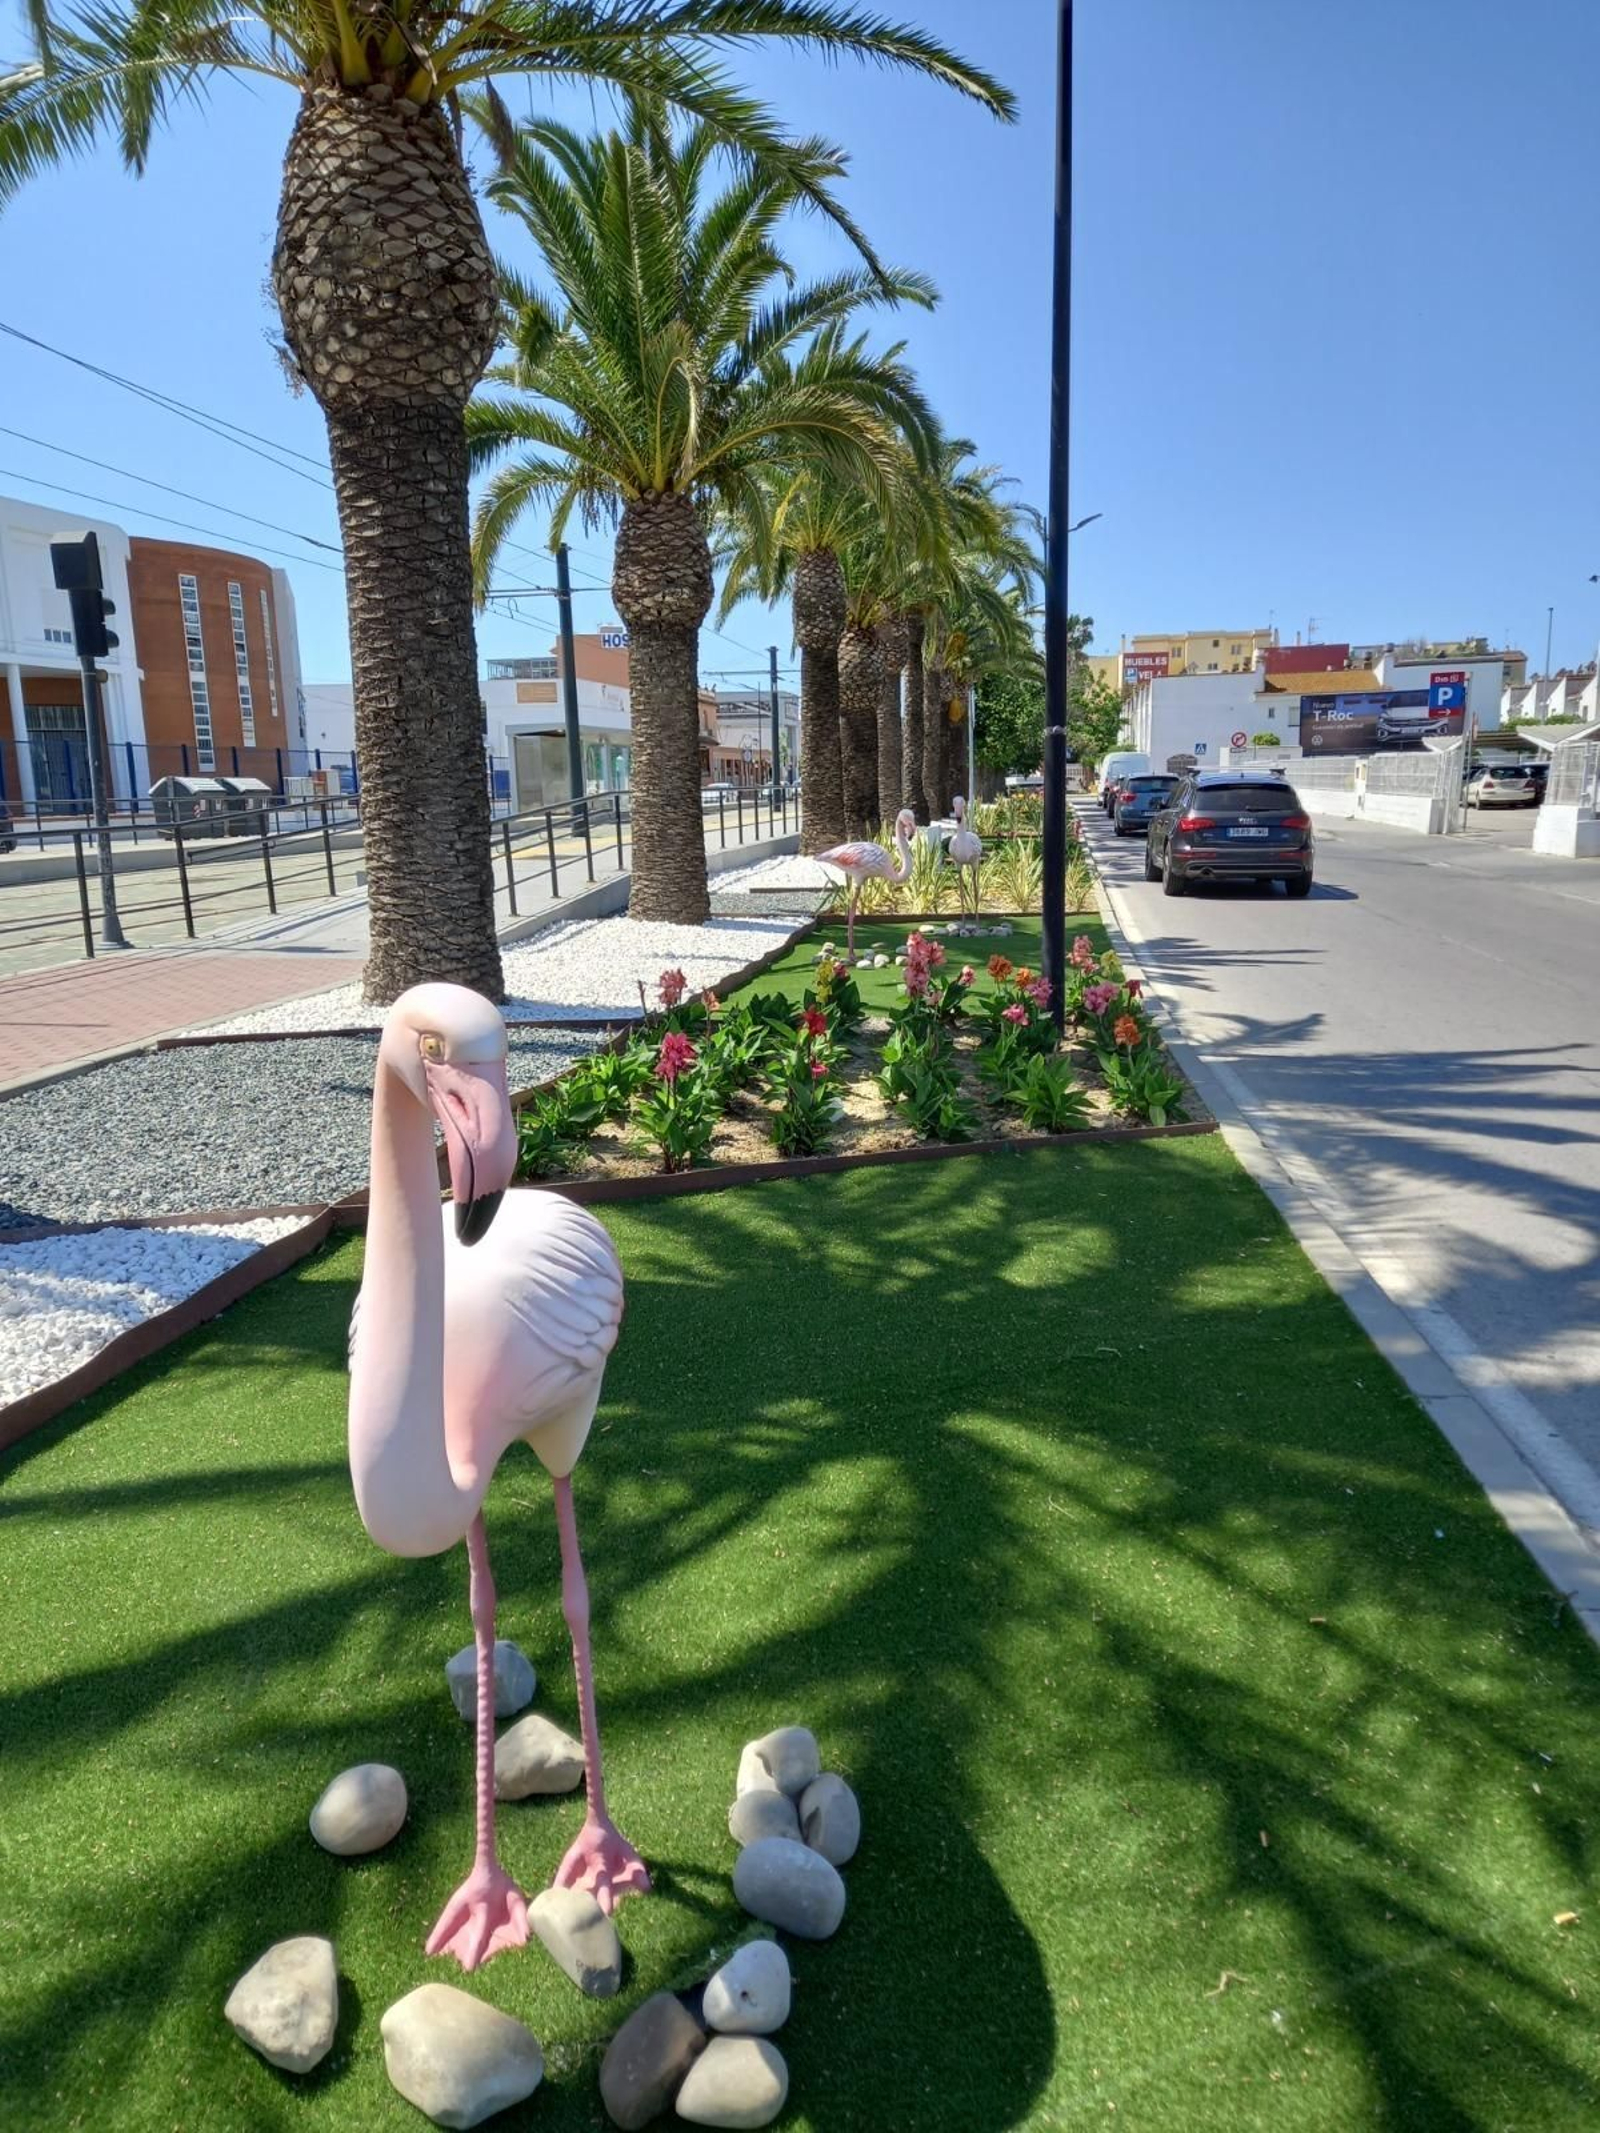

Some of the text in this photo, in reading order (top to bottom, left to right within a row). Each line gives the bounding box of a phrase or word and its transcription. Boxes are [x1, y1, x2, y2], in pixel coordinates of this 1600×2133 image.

[1125, 657, 1167, 666] MUEBLES
[1438, 687, 1453, 706] P
[1312, 710, 1354, 721] T-Roc
